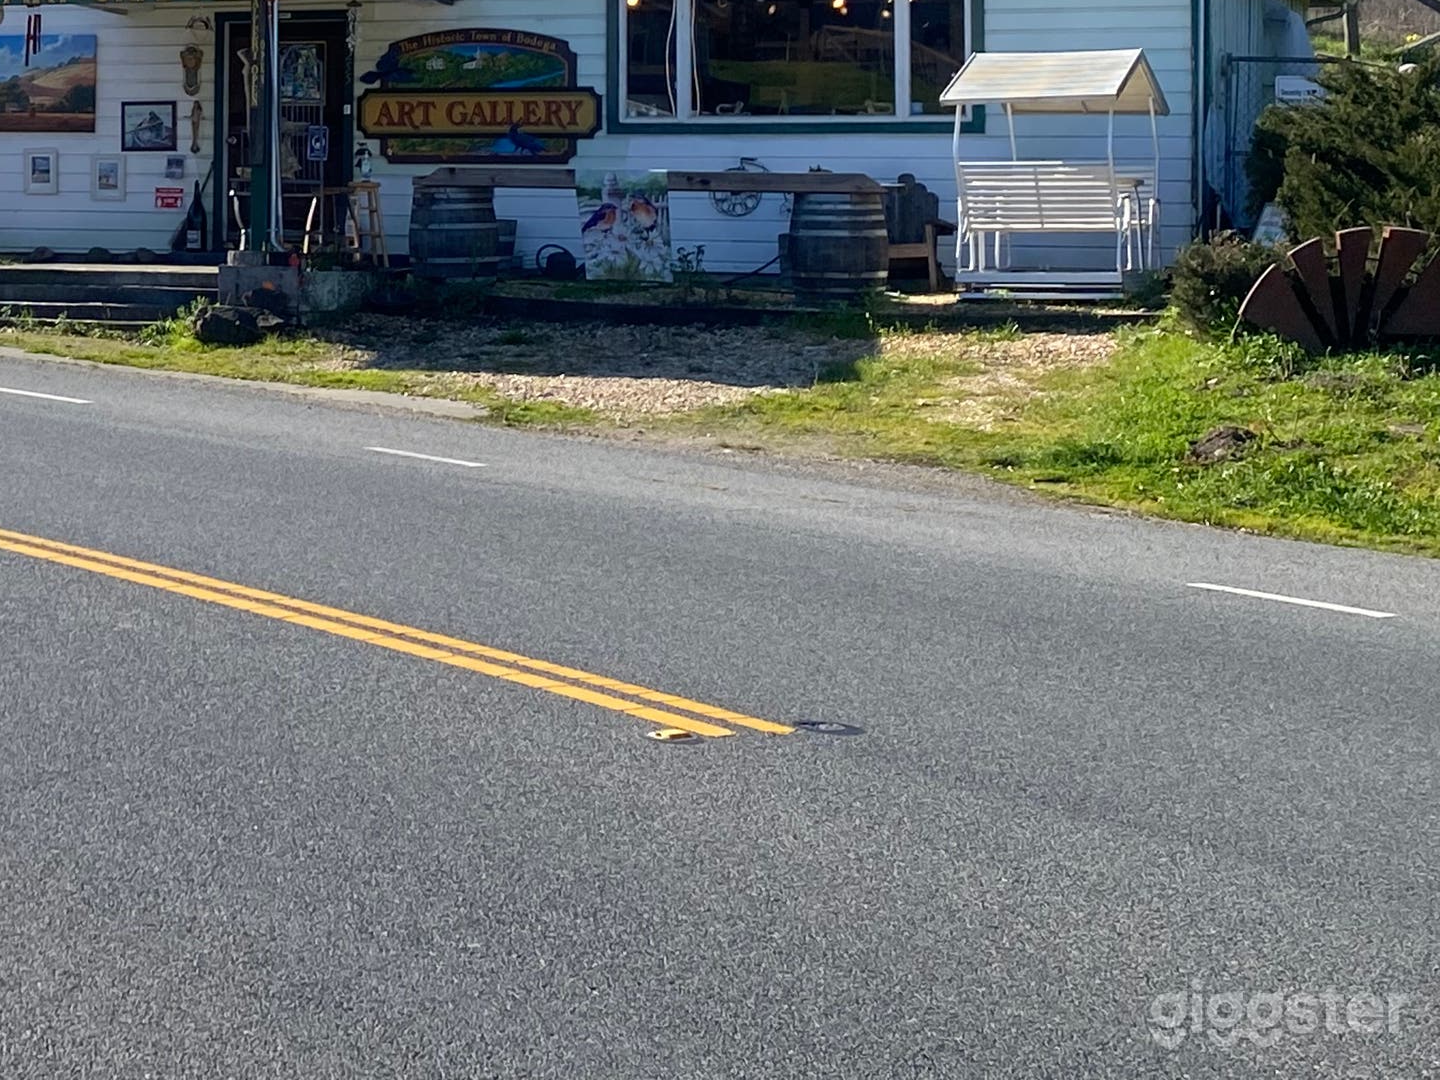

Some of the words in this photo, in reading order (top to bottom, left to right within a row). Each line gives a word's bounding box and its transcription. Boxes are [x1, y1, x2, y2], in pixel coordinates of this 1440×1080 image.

[399, 42, 419, 52] The
[422, 32, 465, 47] Historic
[471, 31, 497, 42] Town
[501, 31, 512, 43] of
[516, 32, 557, 51] Bodega
[373, 100, 436, 129] ART
[445, 99, 584, 129] GALLERY
